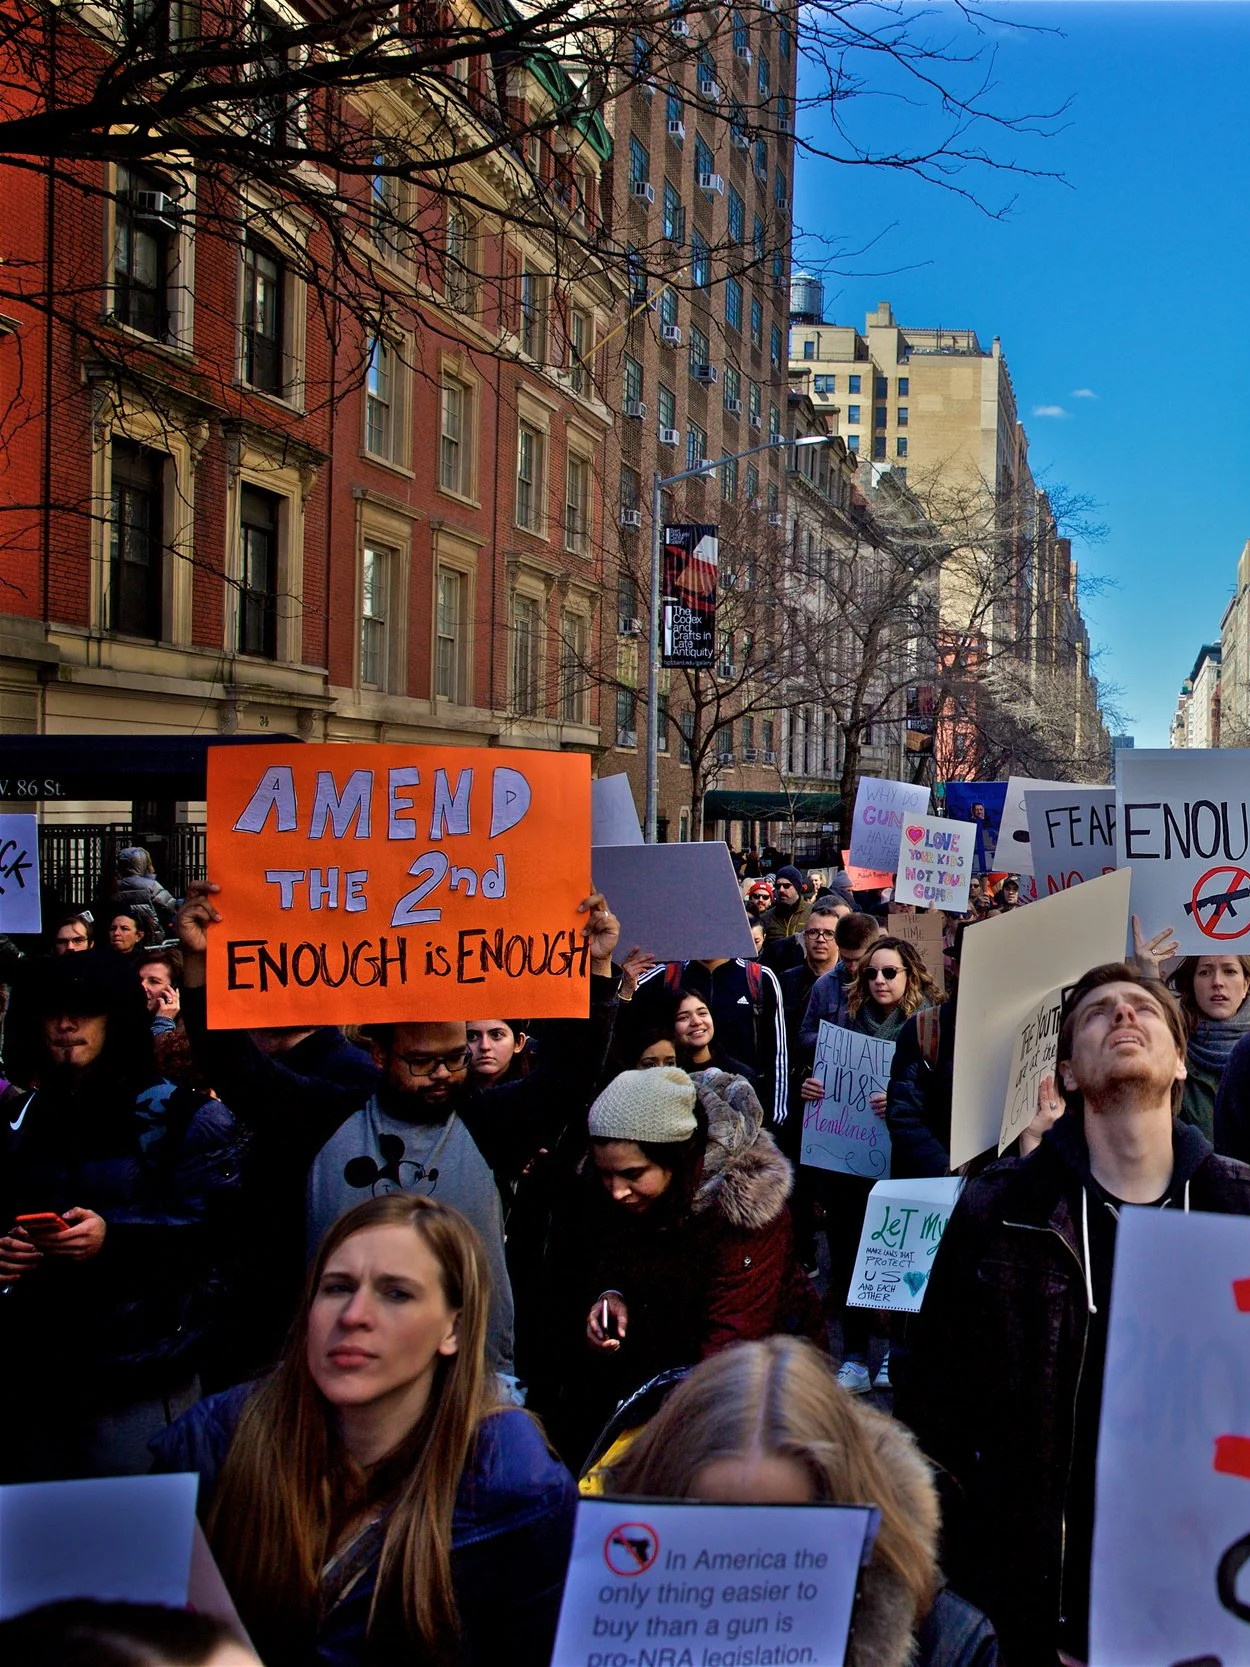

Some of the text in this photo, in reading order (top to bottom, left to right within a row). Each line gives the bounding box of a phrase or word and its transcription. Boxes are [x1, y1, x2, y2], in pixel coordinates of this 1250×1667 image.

[673, 606, 691, 615] The
[673, 614, 702, 623] Codex
[673, 623, 691, 631] and
[673, 631, 712, 640] Crafts in
[673, 640, 694, 649] Late
[673, 647, 714, 658] Antiquity
[17, 779, 38, 796] 86
[44, 779, 66, 796] St.
[866, 786, 919, 806] WHY DO
[232, 765, 532, 841] AMEND
[865, 831, 899, 846] HAVE
[925, 829, 961, 853] LOVE
[909, 849, 964, 867] YOUR KIDS
[905, 867, 966, 887] NOT YOUR
[265, 850, 507, 928] THE 2nd
[913, 883, 954, 901] GUNS
[903, 925, 925, 940] TIME
[227, 927, 589, 992] ENOUGH is ENOUGH
[817, 1022, 892, 1078] REGULATE
[1041, 1042, 1057, 1063] the
[803, 1099, 880, 1147] Hemlines
[865, 1247, 882, 1256] MAKE
[883, 1249, 898, 1257] LAWS
[865, 1256, 915, 1269] PROTECT
[864, 1270, 901, 1283] US
[857, 1292, 891, 1302] OTHER
[858, 1283, 896, 1293] AND EACH
[665, 1548, 828, 1571] In America the
[599, 1581, 818, 1610] only thing easier to
[592, 1613, 794, 1642] buy than a gun is
[587, 1646, 819, 1667] pro-NRA legislation.
